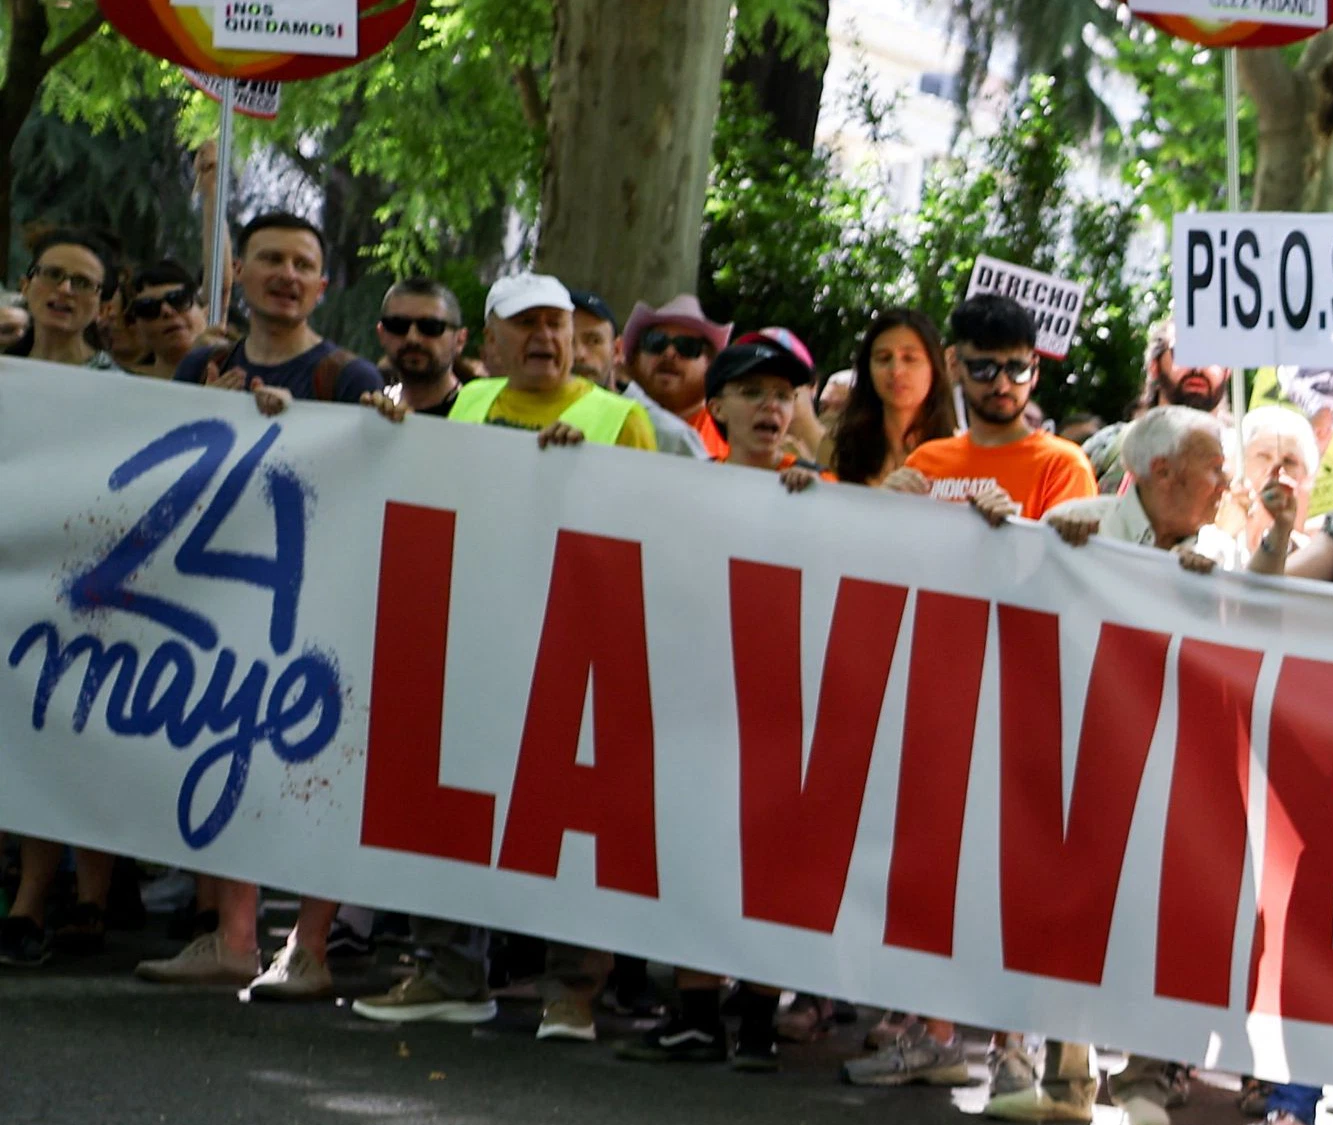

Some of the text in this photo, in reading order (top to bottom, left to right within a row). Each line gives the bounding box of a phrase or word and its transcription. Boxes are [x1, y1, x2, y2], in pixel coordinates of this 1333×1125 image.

[977, 266, 1079, 312] DERECHO
[69, 417, 308, 655] 24
[929, 477, 997, 498] INDICATO
[8, 619, 343, 850] mayo
[360, 499, 660, 900] LA
